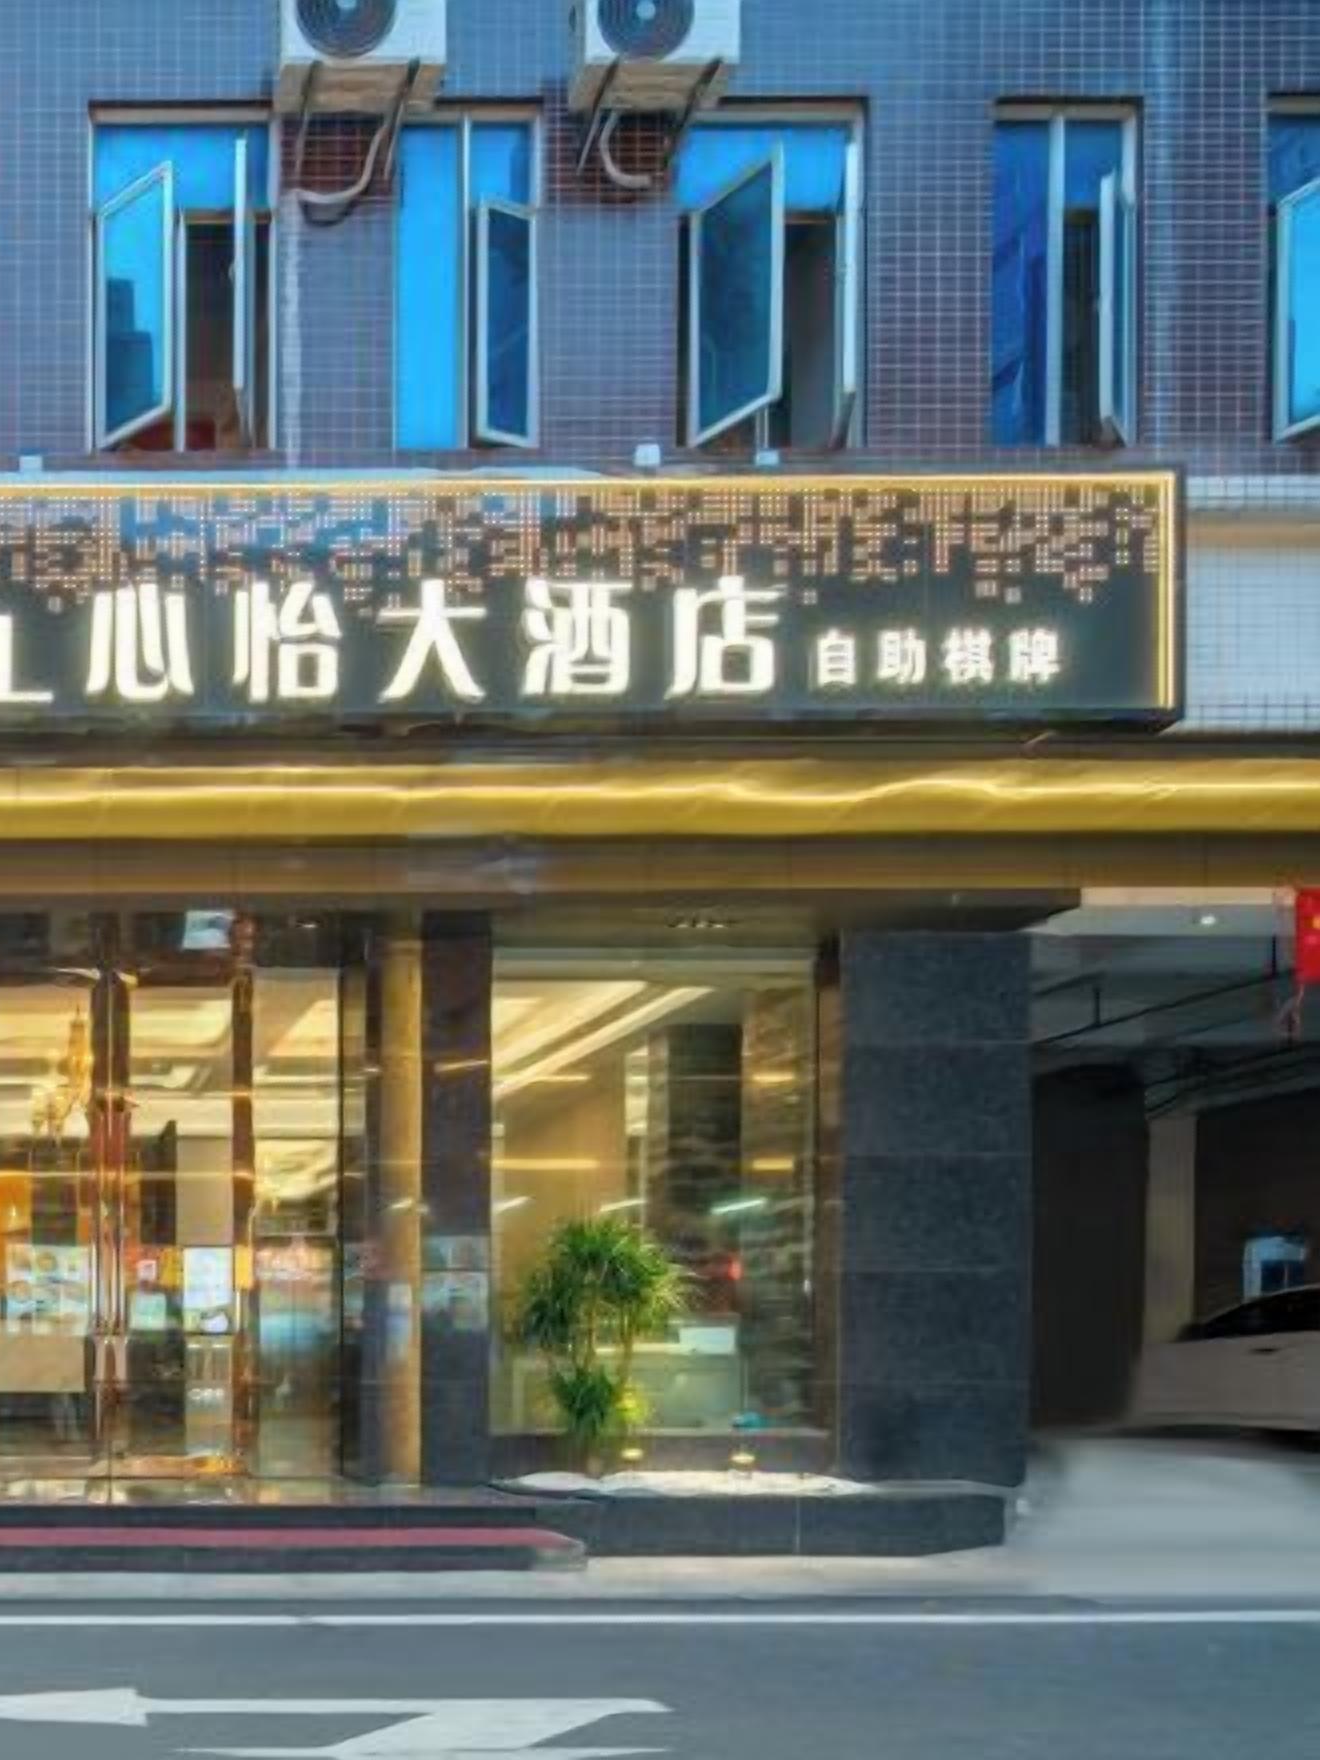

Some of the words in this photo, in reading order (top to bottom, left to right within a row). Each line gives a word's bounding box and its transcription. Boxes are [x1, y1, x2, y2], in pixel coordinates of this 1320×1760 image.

[85, 575, 784, 701] 心怡大酒店
[815, 627, 1062, 686] 自助棋牌
